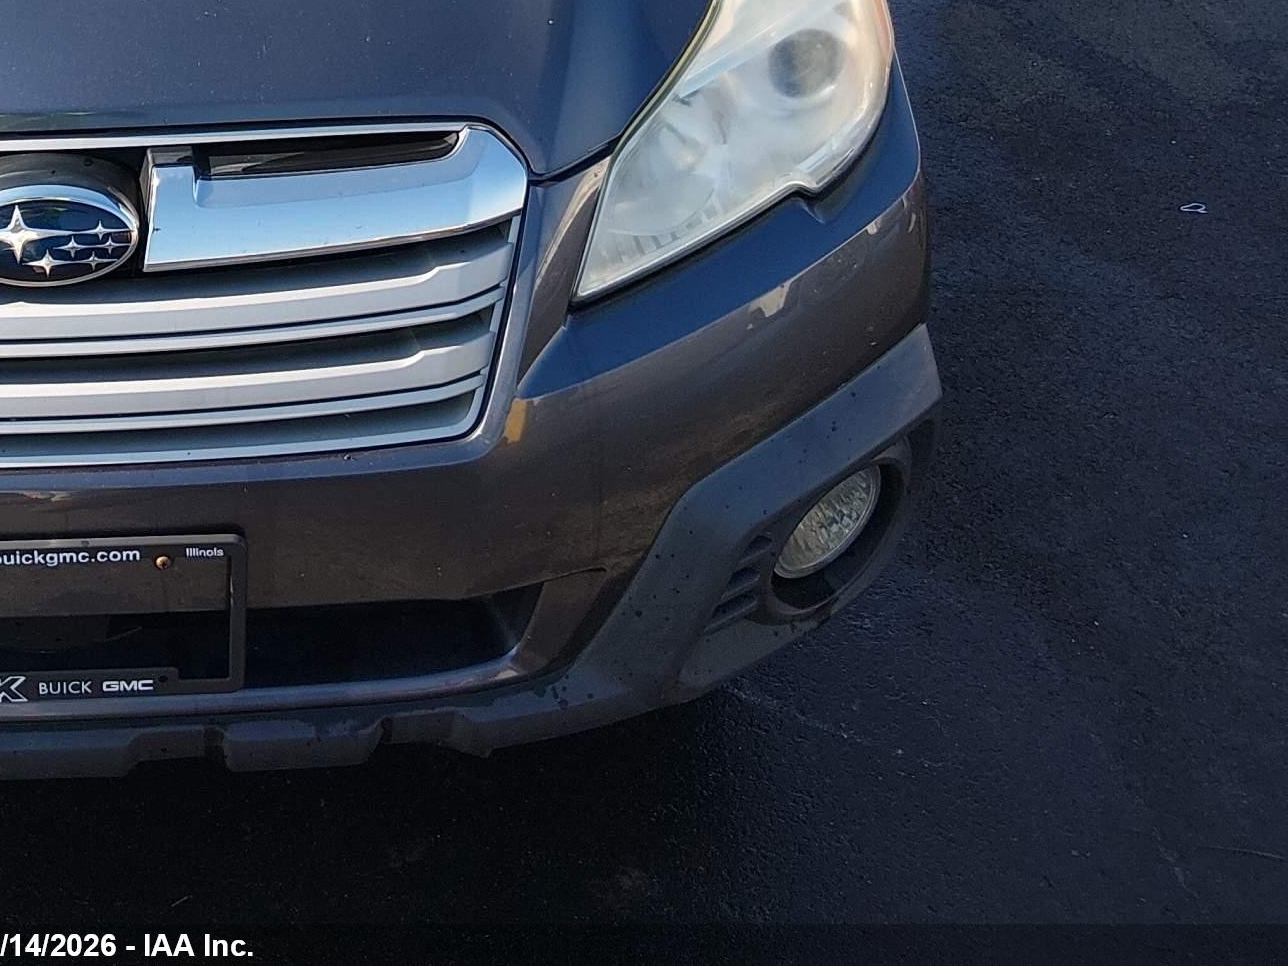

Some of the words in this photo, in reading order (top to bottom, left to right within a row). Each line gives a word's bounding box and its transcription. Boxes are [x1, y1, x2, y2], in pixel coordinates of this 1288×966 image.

[185, 547, 224, 557] Illinois
[38, 681, 92, 694] BUICK
[102, 679, 154, 692] GMC
